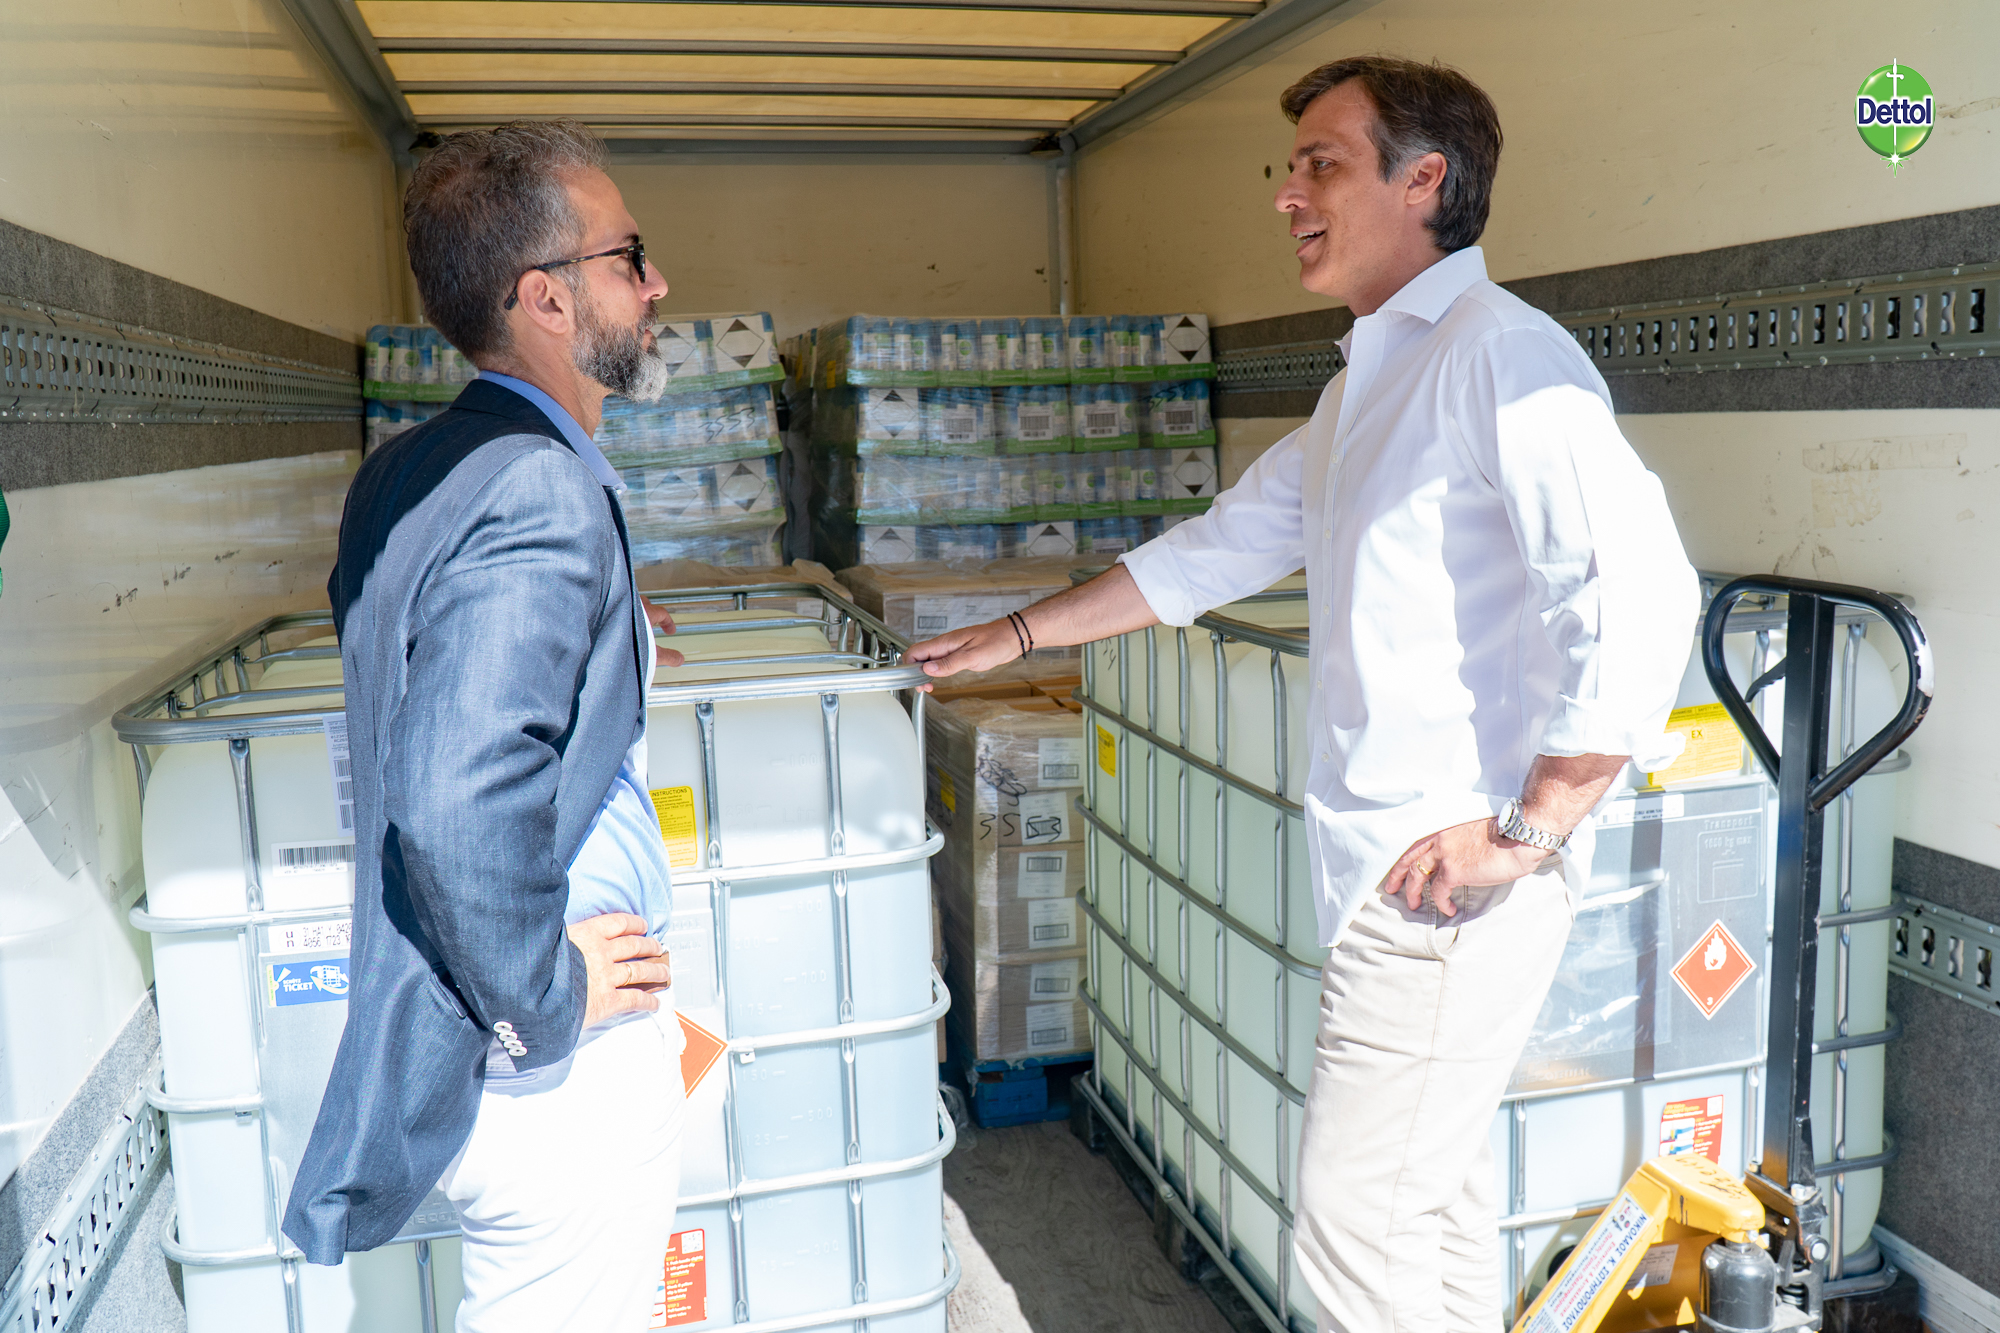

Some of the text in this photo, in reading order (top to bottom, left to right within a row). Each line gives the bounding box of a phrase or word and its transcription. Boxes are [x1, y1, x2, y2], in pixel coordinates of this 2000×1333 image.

[1691, 729, 1703, 739] EX
[651, 788, 687, 797] INSTRUCTIONS
[1704, 815, 1753, 831] Transport
[733, 936, 761, 950] 200
[801, 969, 828, 985] 700
[283, 982, 313, 992] TICKET
[1707, 997, 1713, 1005] 3
[738, 1002, 765, 1017] 175
[741, 1067, 768, 1082] 150
[807, 1106, 834, 1122] 500
[744, 1132, 772, 1148] 125
[1614, 1212, 1647, 1257] ΝΙΚΟΛΑΟΣ
[813, 1240, 840, 1256] 300
[1561, 1265, 1610, 1331] ΣΩΤΗΡΟΠΟΥΛΟΣ
